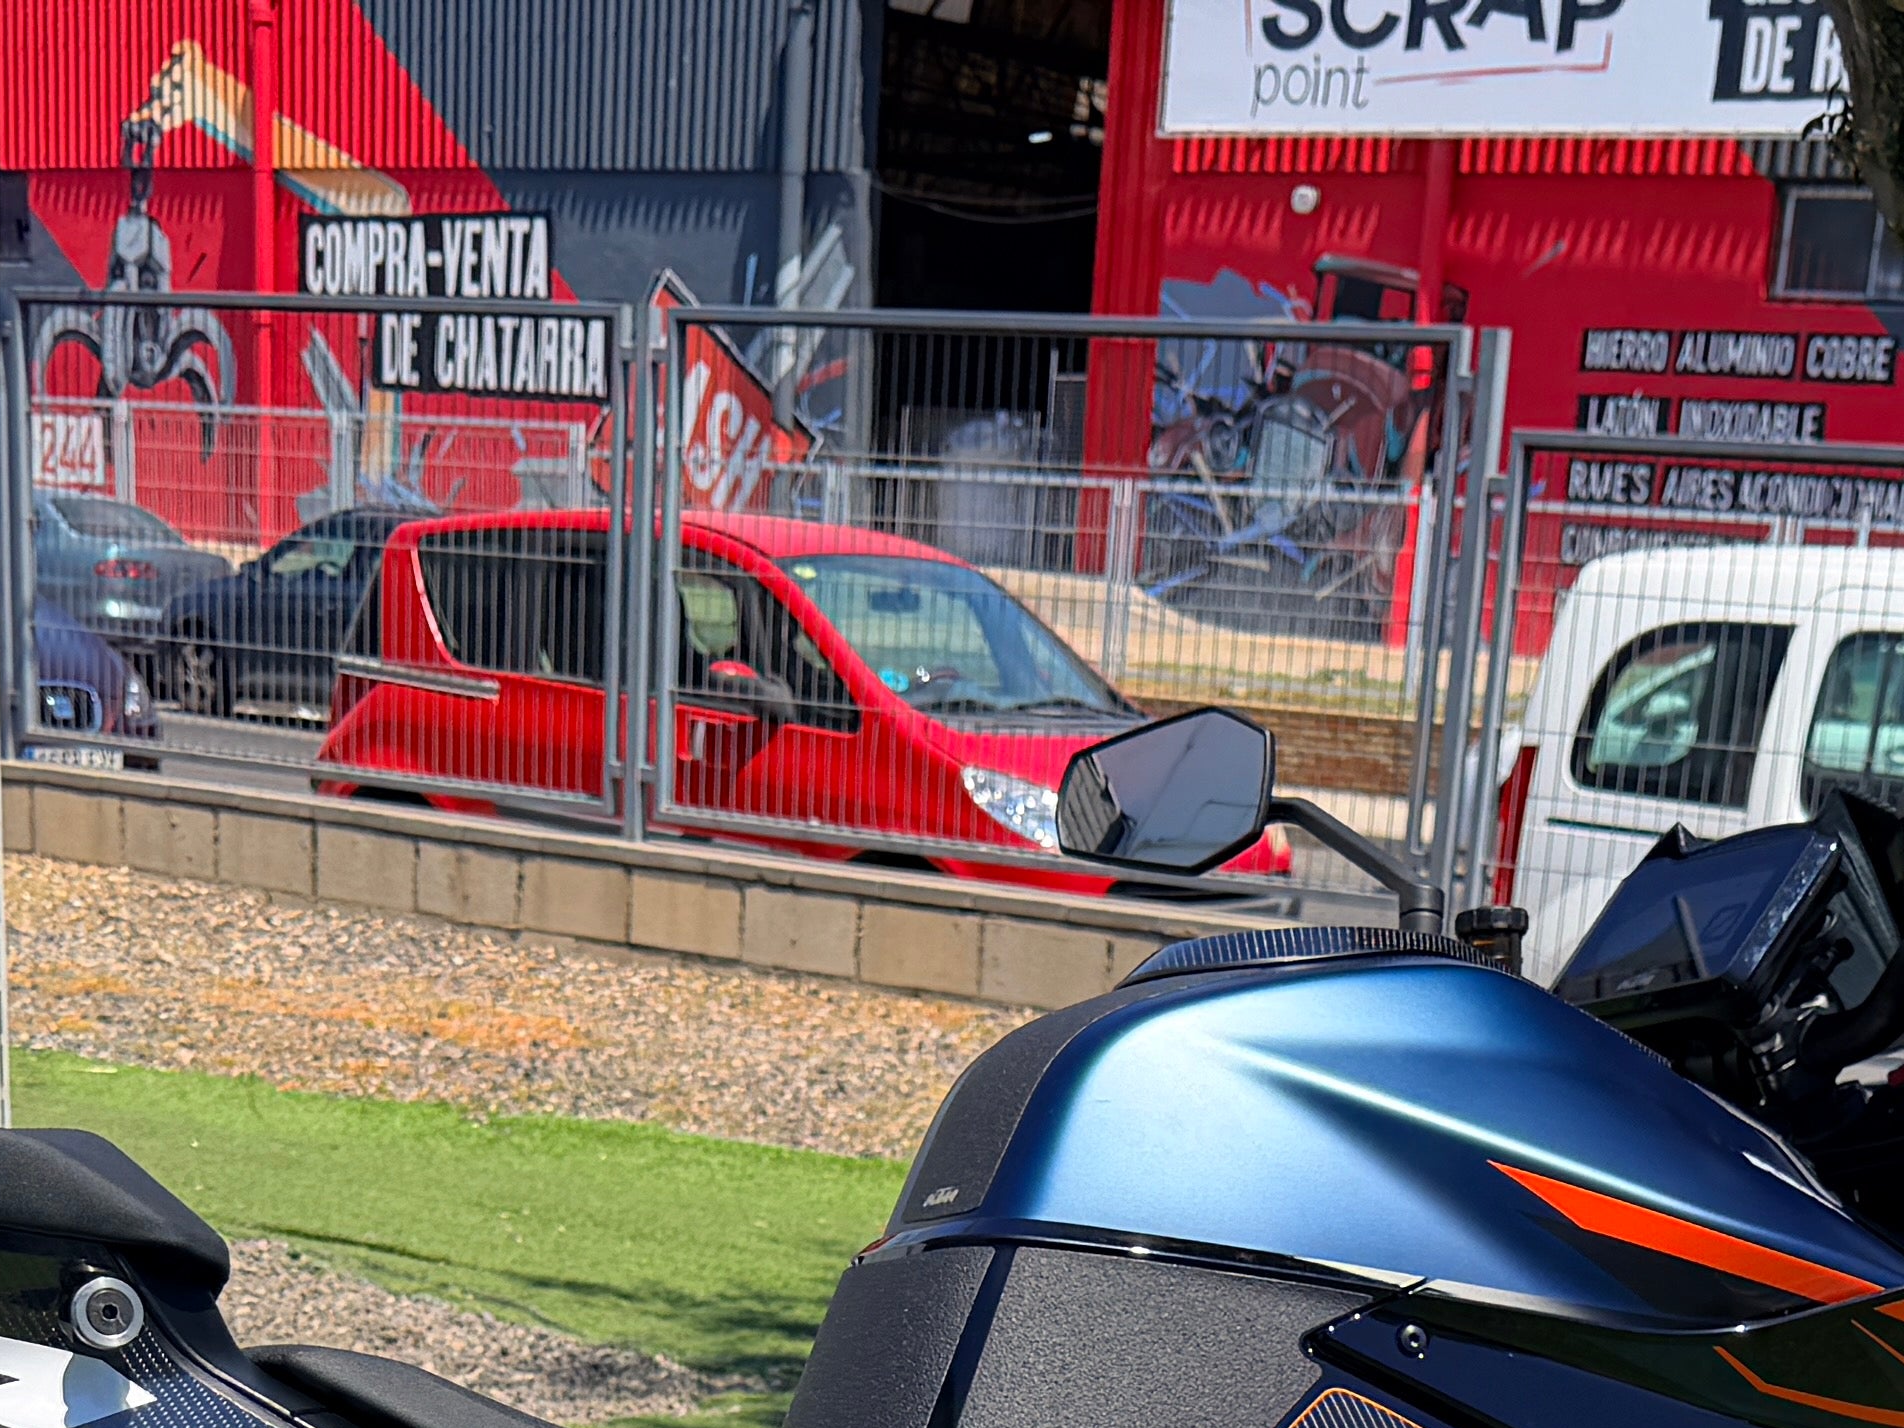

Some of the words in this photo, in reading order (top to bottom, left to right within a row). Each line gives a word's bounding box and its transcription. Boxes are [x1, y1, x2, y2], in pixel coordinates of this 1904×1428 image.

[1250, 52, 1369, 118] point
[1739, 16, 1802, 93] DE
[305, 216, 550, 300] COMPRA-VENTA
[380, 313, 421, 387] DE
[433, 315, 608, 397] CHATARRA
[1584, 329, 1669, 373] HIERRO
[1675, 331, 1795, 377] ALUMINIO
[1805, 335, 1895, 381] COBRE
